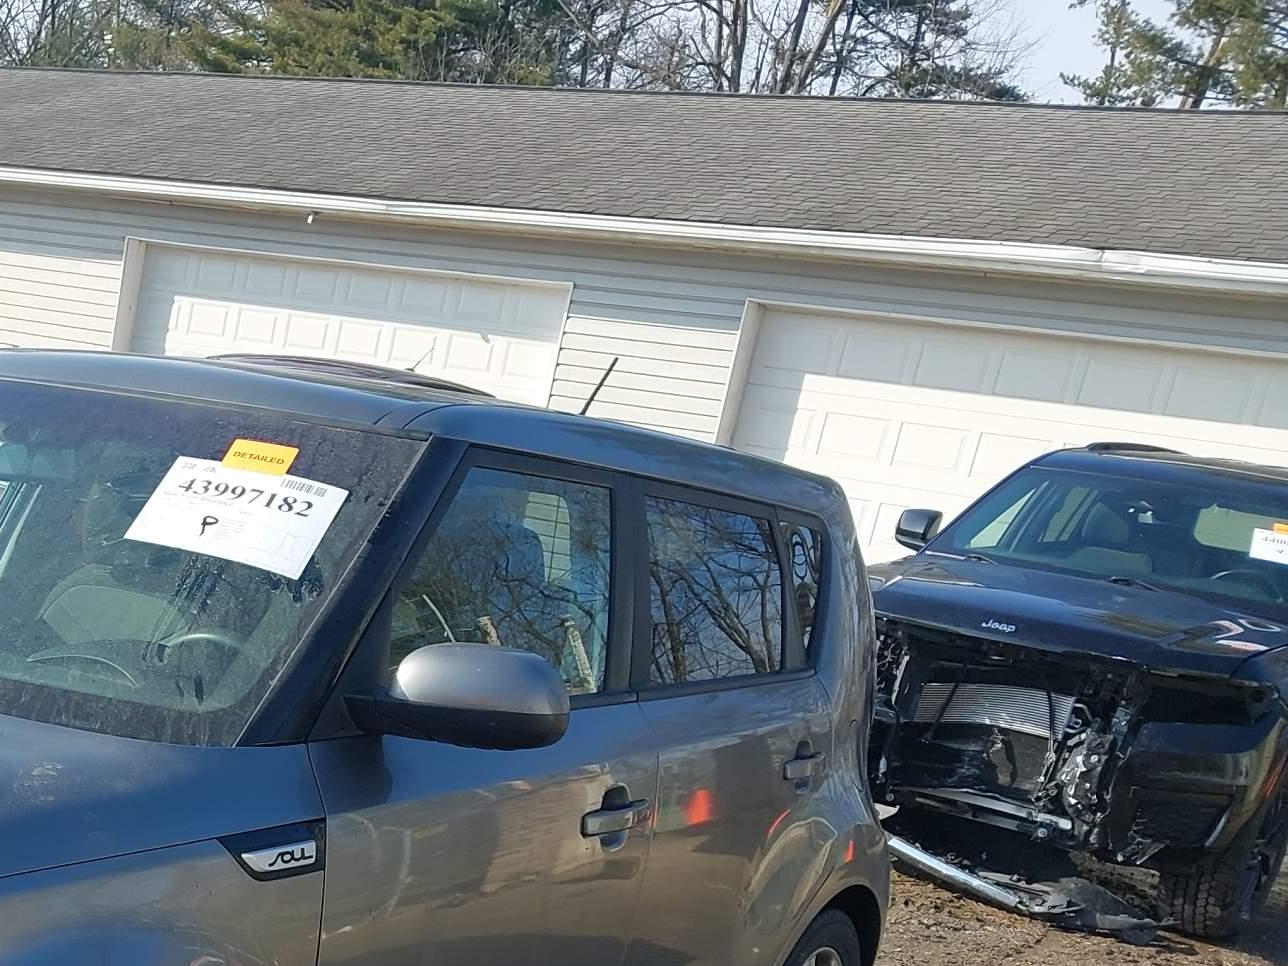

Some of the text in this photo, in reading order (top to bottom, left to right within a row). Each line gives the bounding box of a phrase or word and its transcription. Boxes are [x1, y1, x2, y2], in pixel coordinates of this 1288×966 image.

[232, 450, 285, 465] DETAILED
[177, 478, 314, 517] 43997182
[981, 619, 1016, 633] Jeep
